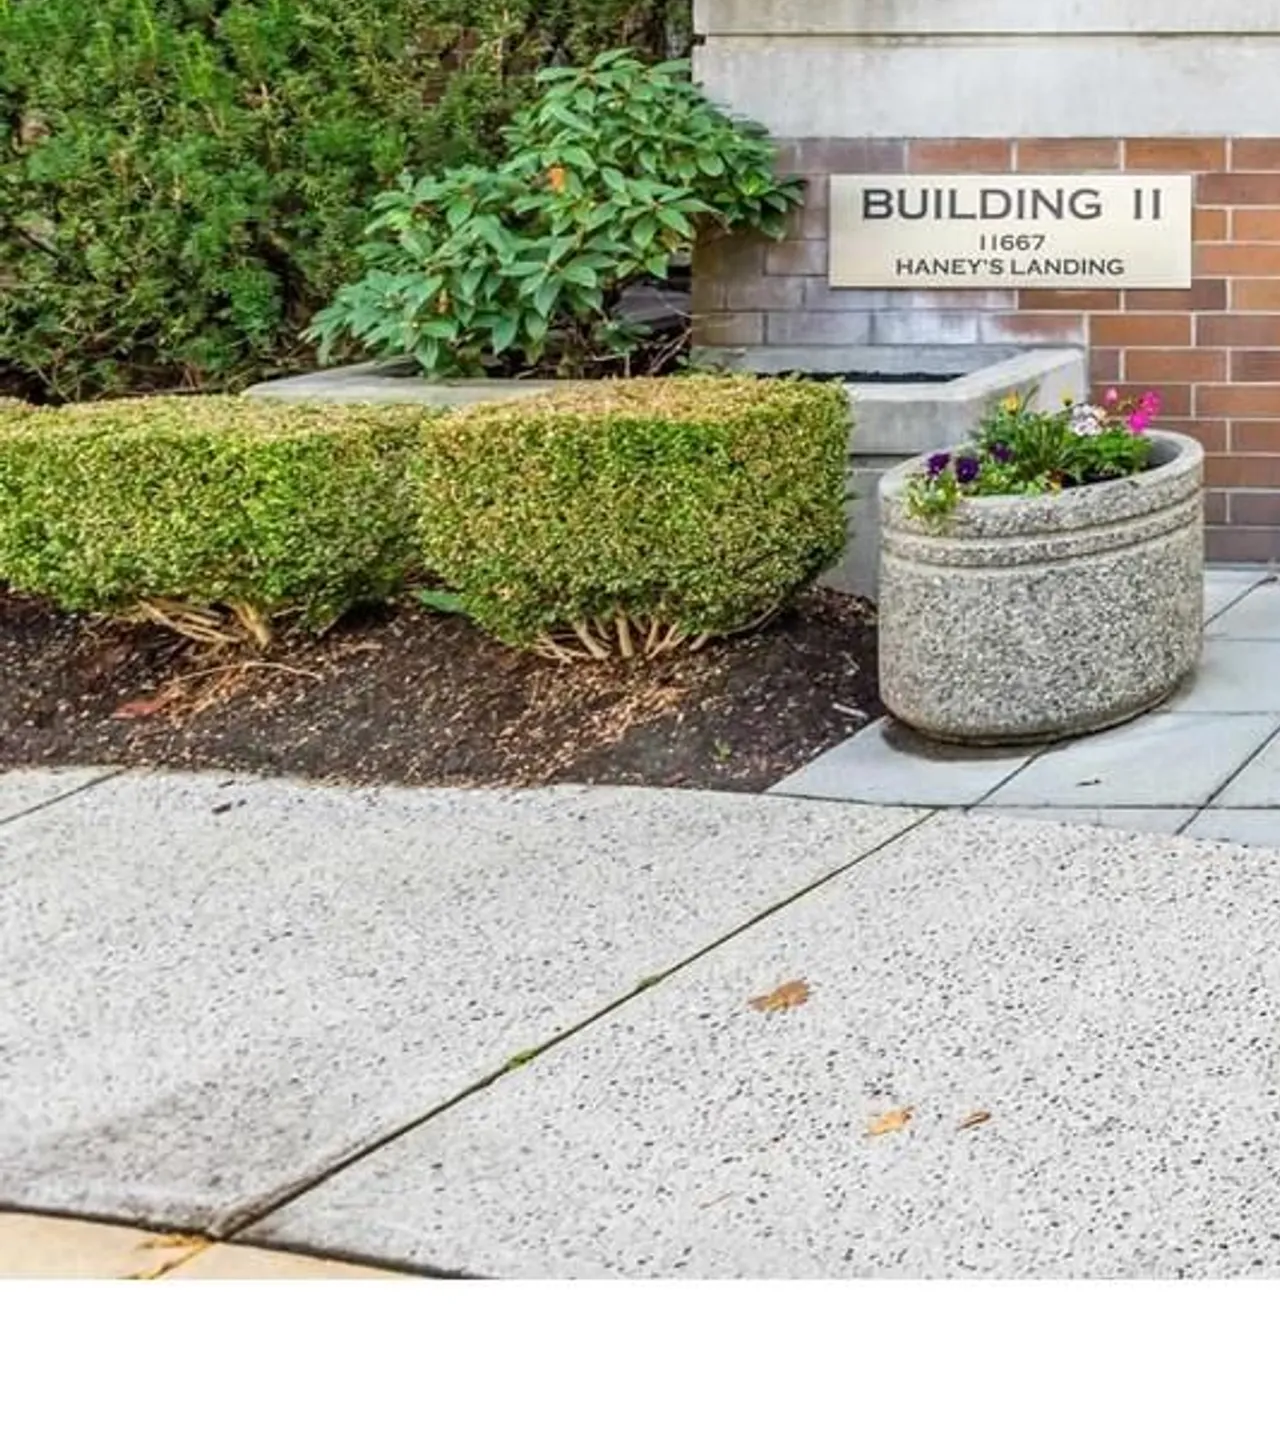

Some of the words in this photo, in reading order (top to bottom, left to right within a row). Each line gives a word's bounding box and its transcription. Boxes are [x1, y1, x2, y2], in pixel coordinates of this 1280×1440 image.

[862, 188, 1102, 221] BUILDING
[1133, 188, 1162, 221] II
[979, 234, 1046, 251] 11667
[895, 258, 1004, 276] HANEY'S
[1009, 258, 1125, 276] LANDING
